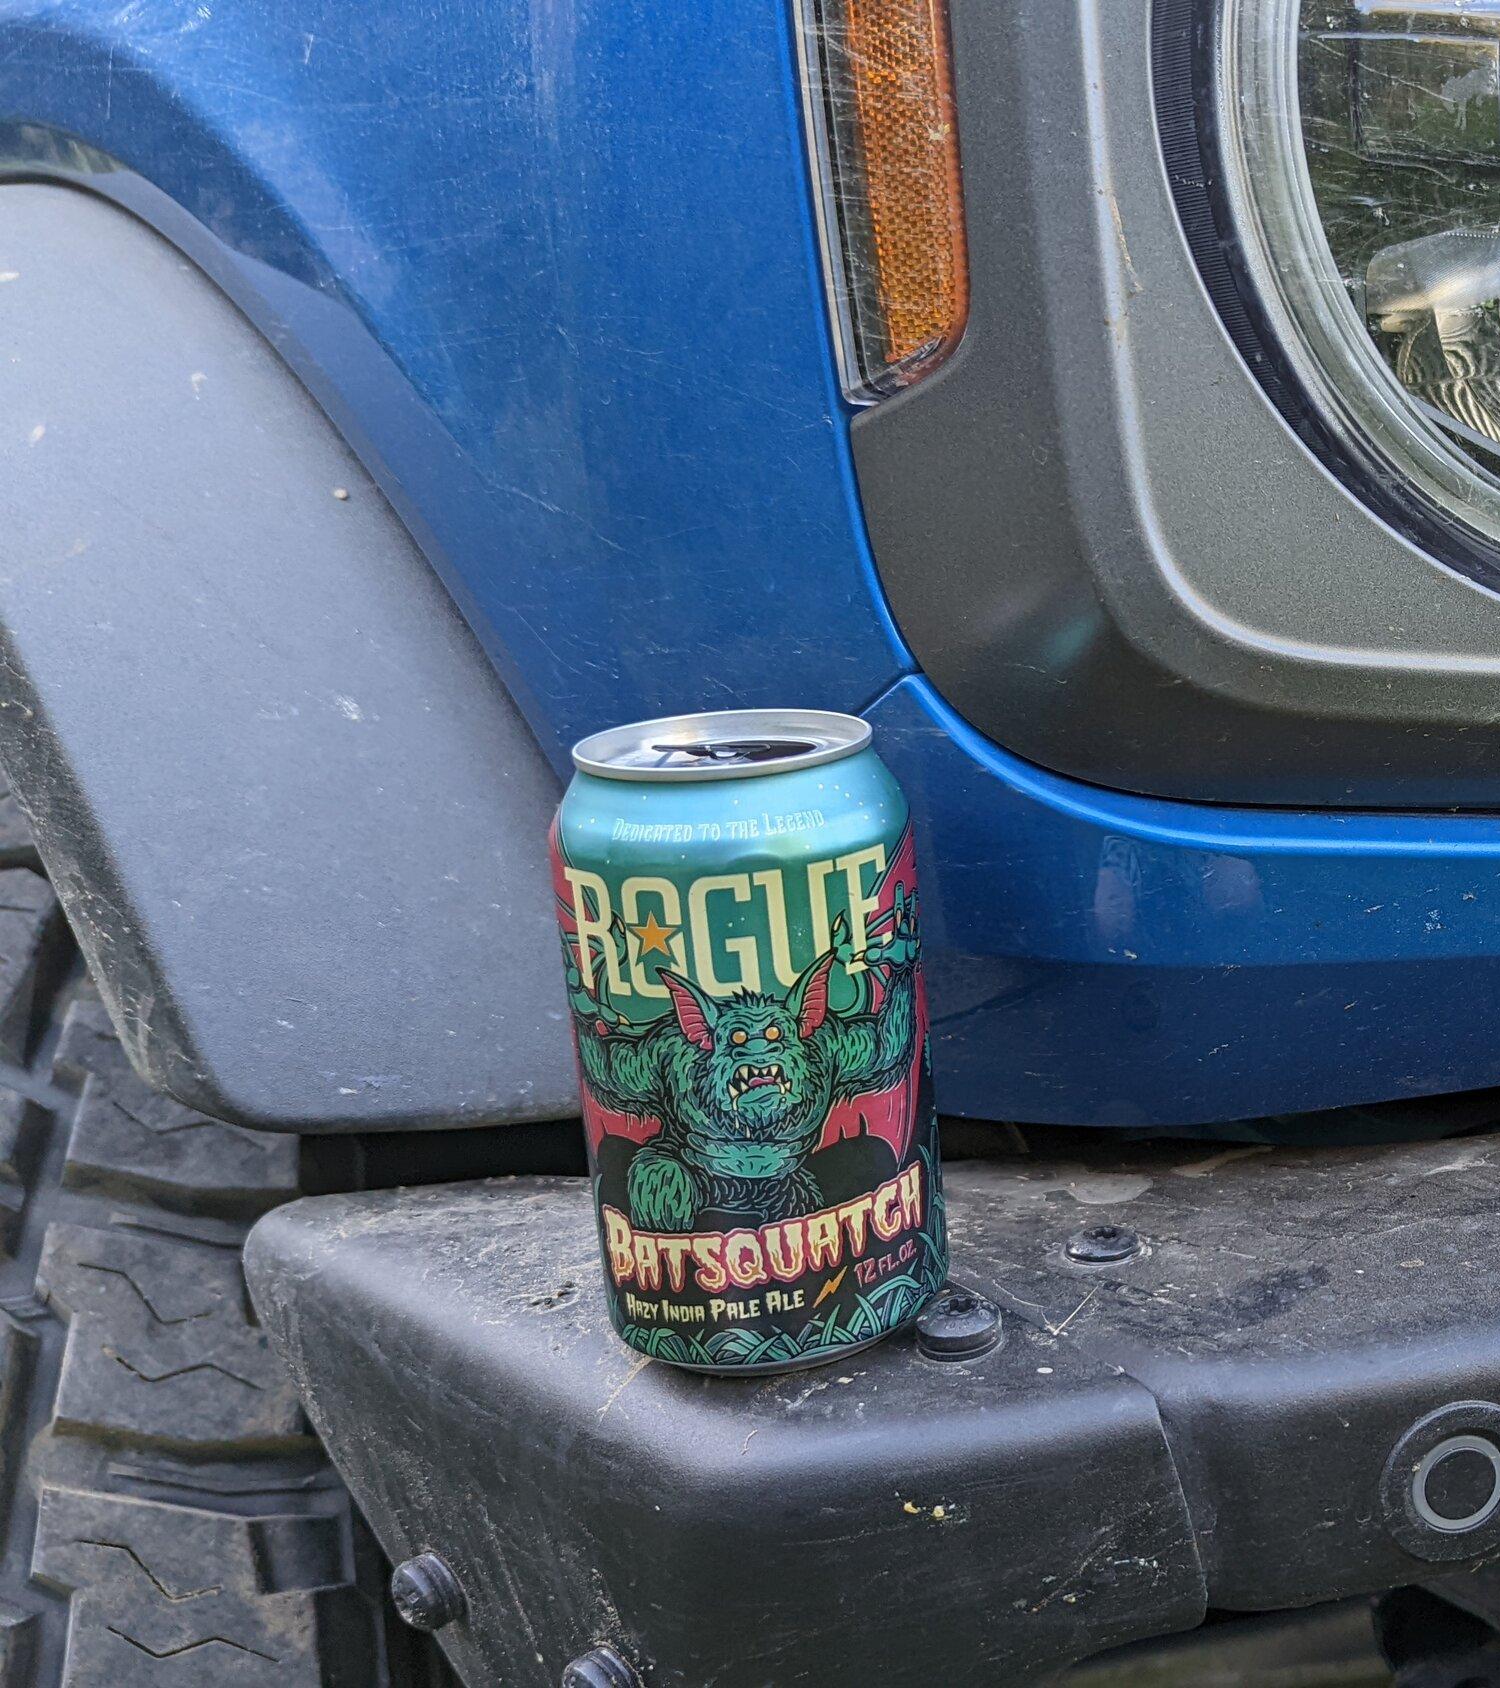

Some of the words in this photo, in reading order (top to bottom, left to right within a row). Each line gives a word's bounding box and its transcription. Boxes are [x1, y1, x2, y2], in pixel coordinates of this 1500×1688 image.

[612, 818, 693, 842] DEDICATED
[699, 823, 721, 841] TO
[726, 820, 760, 840] THE
[762, 810, 825, 836] LEGEND
[564, 843, 887, 998] ROGUE
[603, 1163, 924, 1293] BATSQUATCH
[853, 1257, 877, 1288] 12
[626, 1292, 659, 1321] HAZY
[663, 1294, 705, 1322] INDIA
[709, 1297, 761, 1323] PALE
[766, 1289, 805, 1313] ALE
